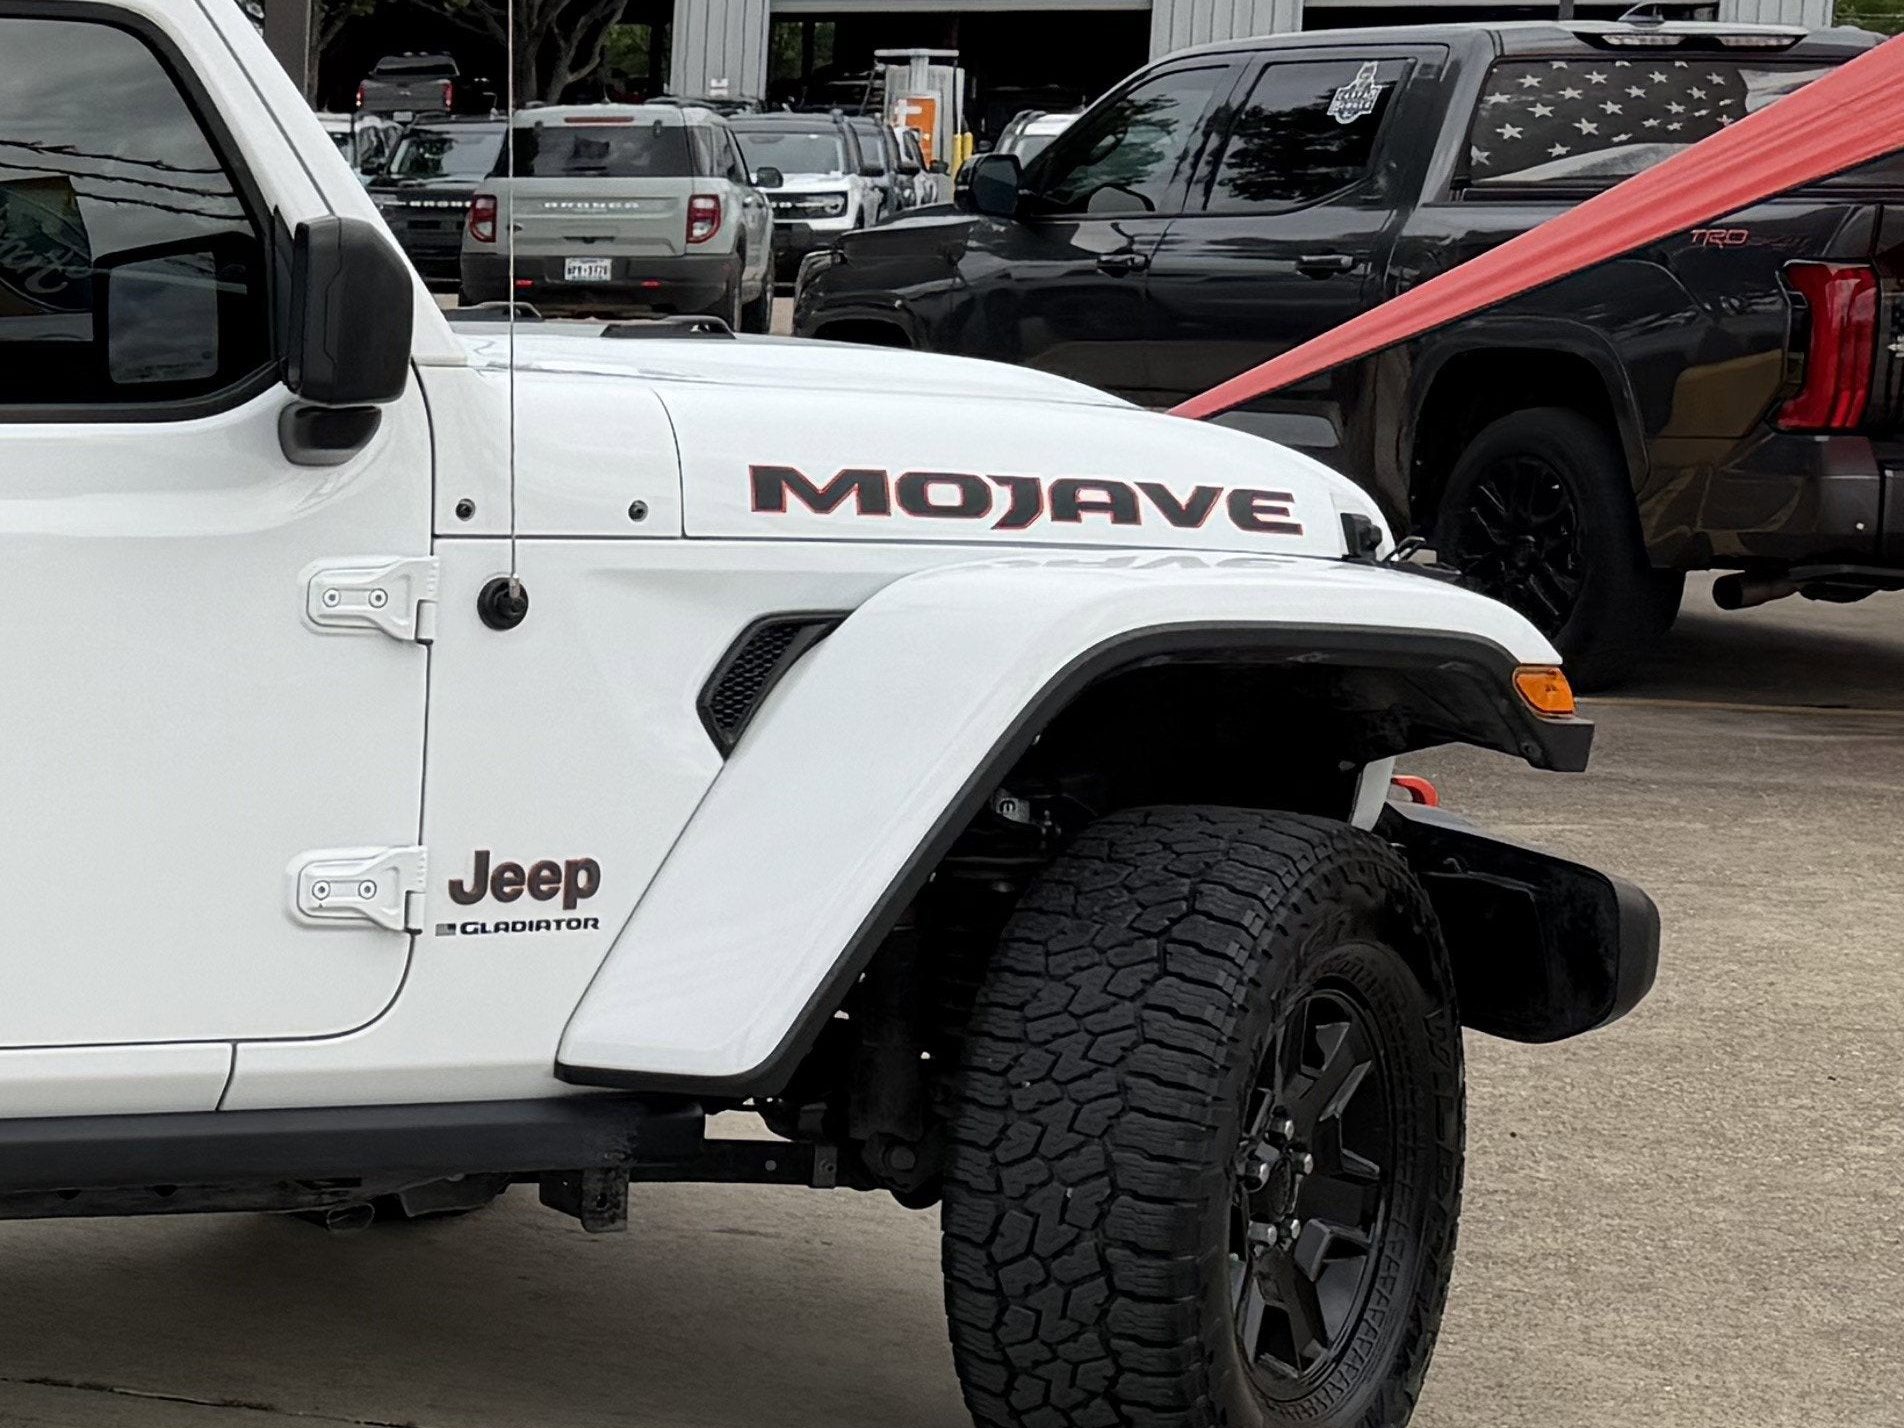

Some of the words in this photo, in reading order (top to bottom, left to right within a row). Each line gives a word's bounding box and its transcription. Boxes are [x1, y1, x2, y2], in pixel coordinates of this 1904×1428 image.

[1691, 228, 1749, 249] TRD
[748, 464, 1304, 536] MOJAVE
[448, 849, 601, 910] Jeep
[460, 917, 600, 935] GLADIATOR
